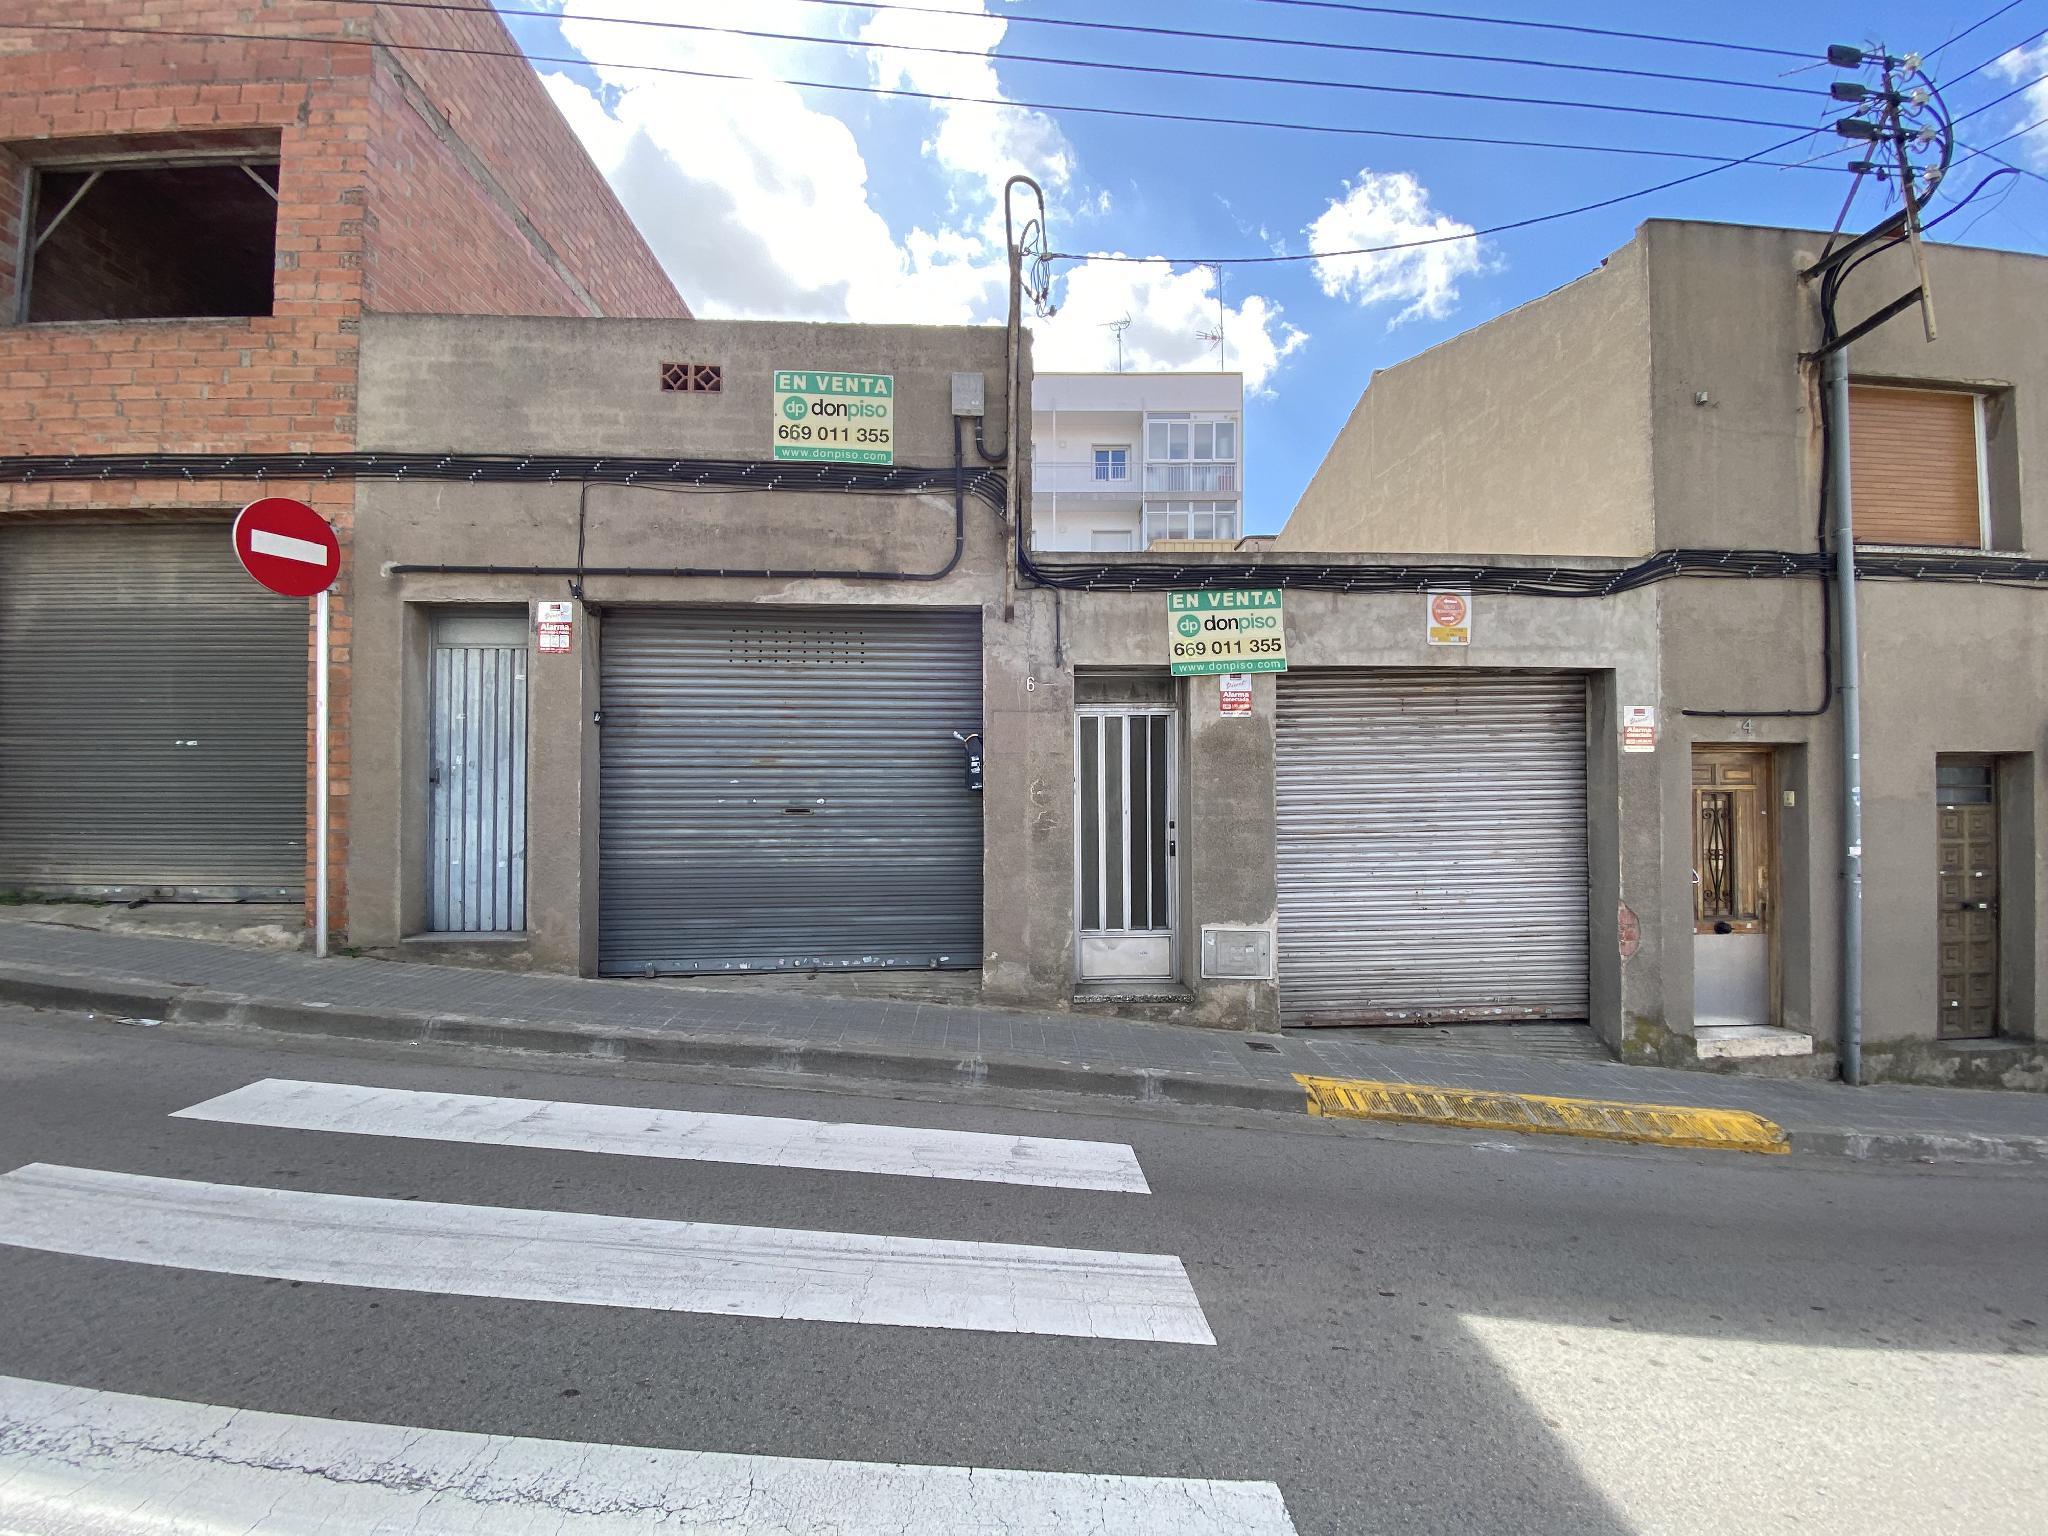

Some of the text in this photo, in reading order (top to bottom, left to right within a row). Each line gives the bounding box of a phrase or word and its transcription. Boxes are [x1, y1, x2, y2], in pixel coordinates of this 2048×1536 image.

[779, 375, 888, 394] EN VENTA
[811, 399, 887, 421] donpiso
[778, 425, 890, 443] 669 011 355
[782, 449, 887, 461] www.donpiso.com
[1172, 591, 1276, 609] EN VENTA
[540, 623, 570, 631] Alarma
[1204, 613, 1276, 633] donpiso
[1174, 638, 1282, 656] 669 011 355
[1179, 660, 1281, 672] www.donpiso.com
[1026, 676, 1035, 691] 6
[1742, 718, 1752, 734] 4
